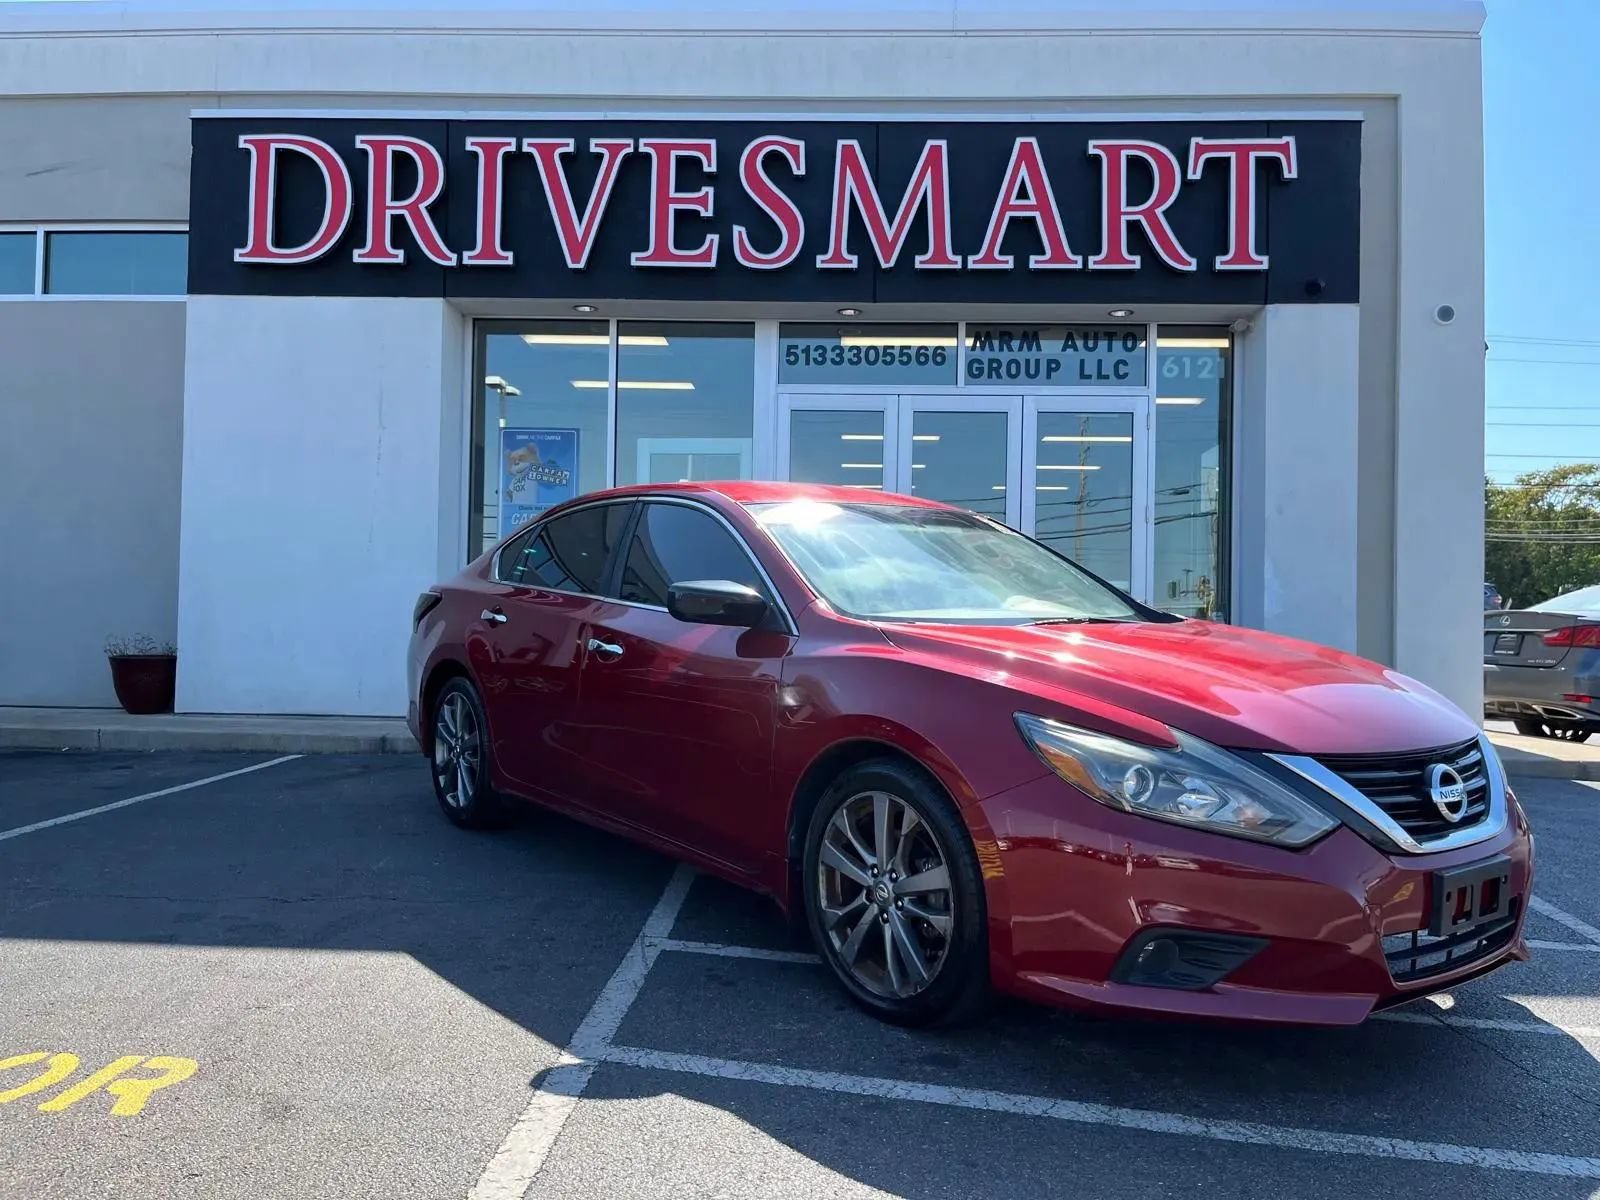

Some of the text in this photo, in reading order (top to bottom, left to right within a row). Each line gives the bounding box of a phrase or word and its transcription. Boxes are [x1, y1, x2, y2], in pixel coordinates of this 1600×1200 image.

[233, 133, 1299, 272] DRIVESMART
[970, 331, 1138, 352] MRM AUTO
[785, 344, 947, 366] 5133305566
[967, 358, 1129, 380] GROUP LLC
